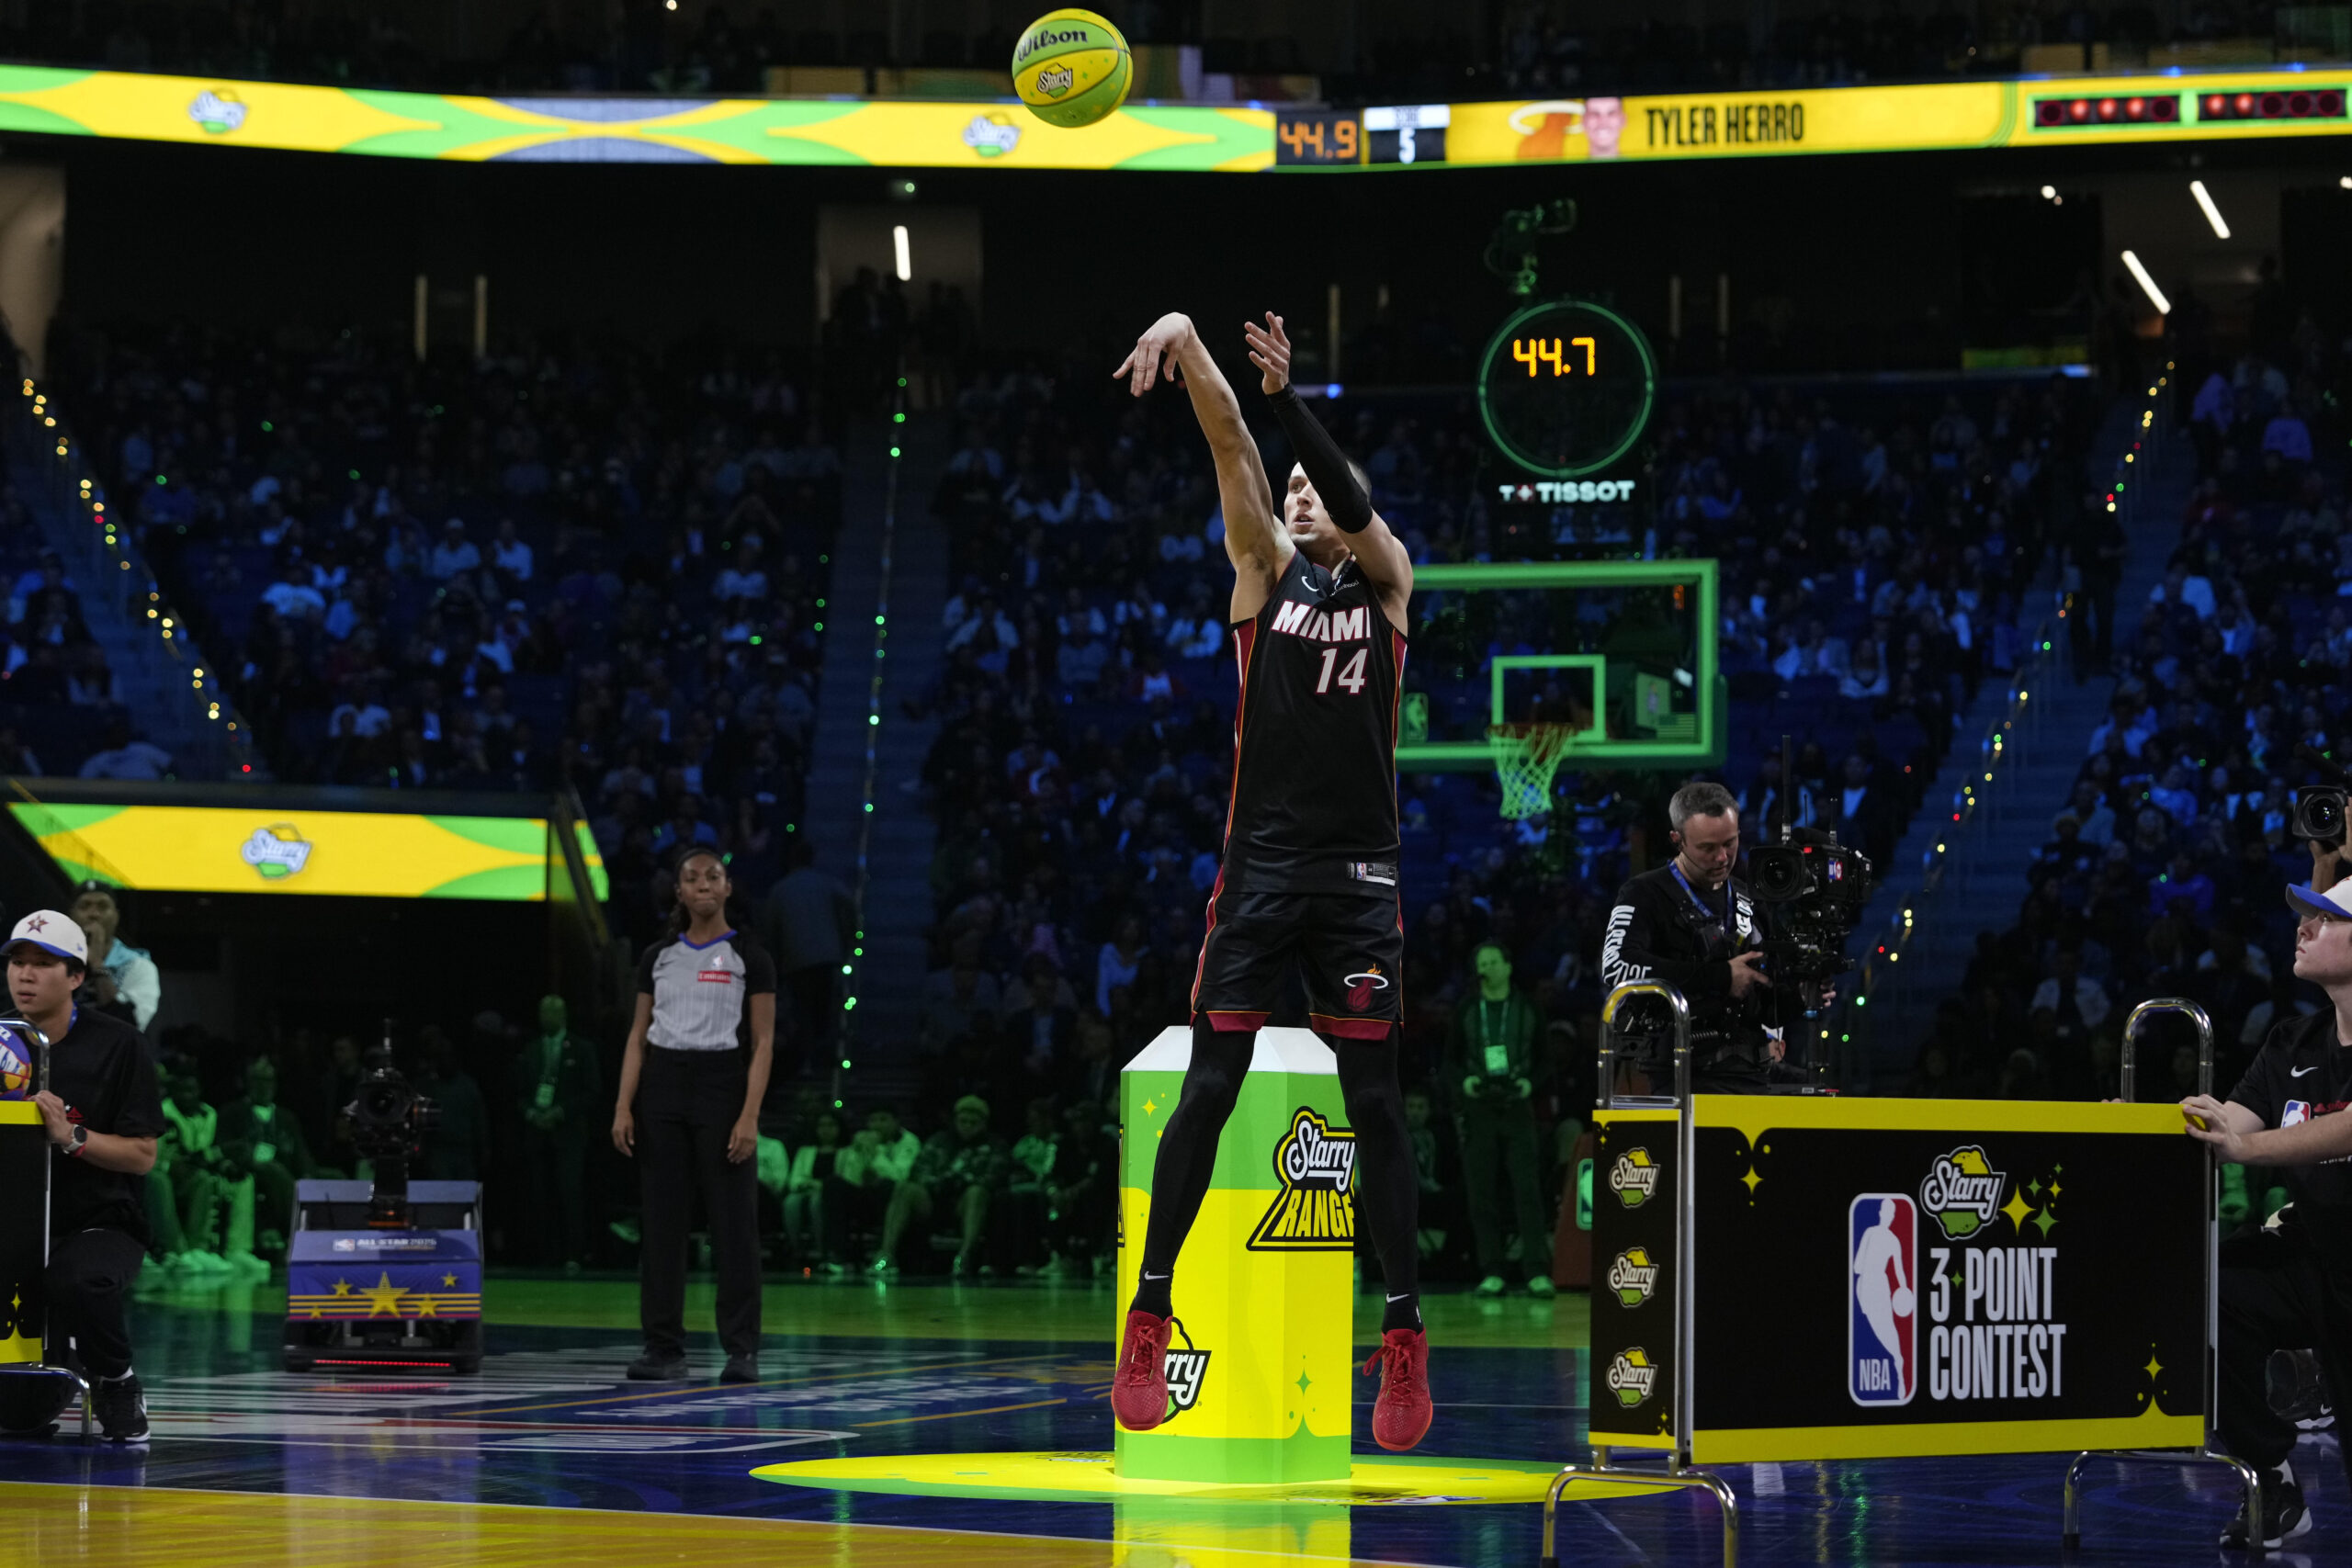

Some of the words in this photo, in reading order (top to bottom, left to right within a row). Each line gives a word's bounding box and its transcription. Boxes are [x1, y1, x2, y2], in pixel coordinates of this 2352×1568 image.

[1017, 30, 1088, 62] Wilson
[1280, 120, 1357, 158] 44.9
[1645, 107, 1716, 145] TYLER
[1726, 103, 1803, 142] HERRO
[1398, 127, 1416, 164] 5
[1513, 337, 1595, 378] 44.7
[1535, 480, 1634, 502] TISSOT
[1271, 599, 1372, 642] MIAMI
[1315, 647, 1369, 694] 14
[1286, 1120, 1355, 1191] Starry
[1611, 1156, 1657, 1196] Starry
[1924, 1160, 2001, 1221] Starry
[1610, 1256, 1656, 1296] Starry
[1929, 1247, 1951, 1323] 3
[1964, 1247, 2058, 1322] POINT
[1608, 1355, 1654, 1396] Starry
[1859, 1359, 1892, 1392] NBA
[1929, 1324, 2067, 1401] CONTEST
